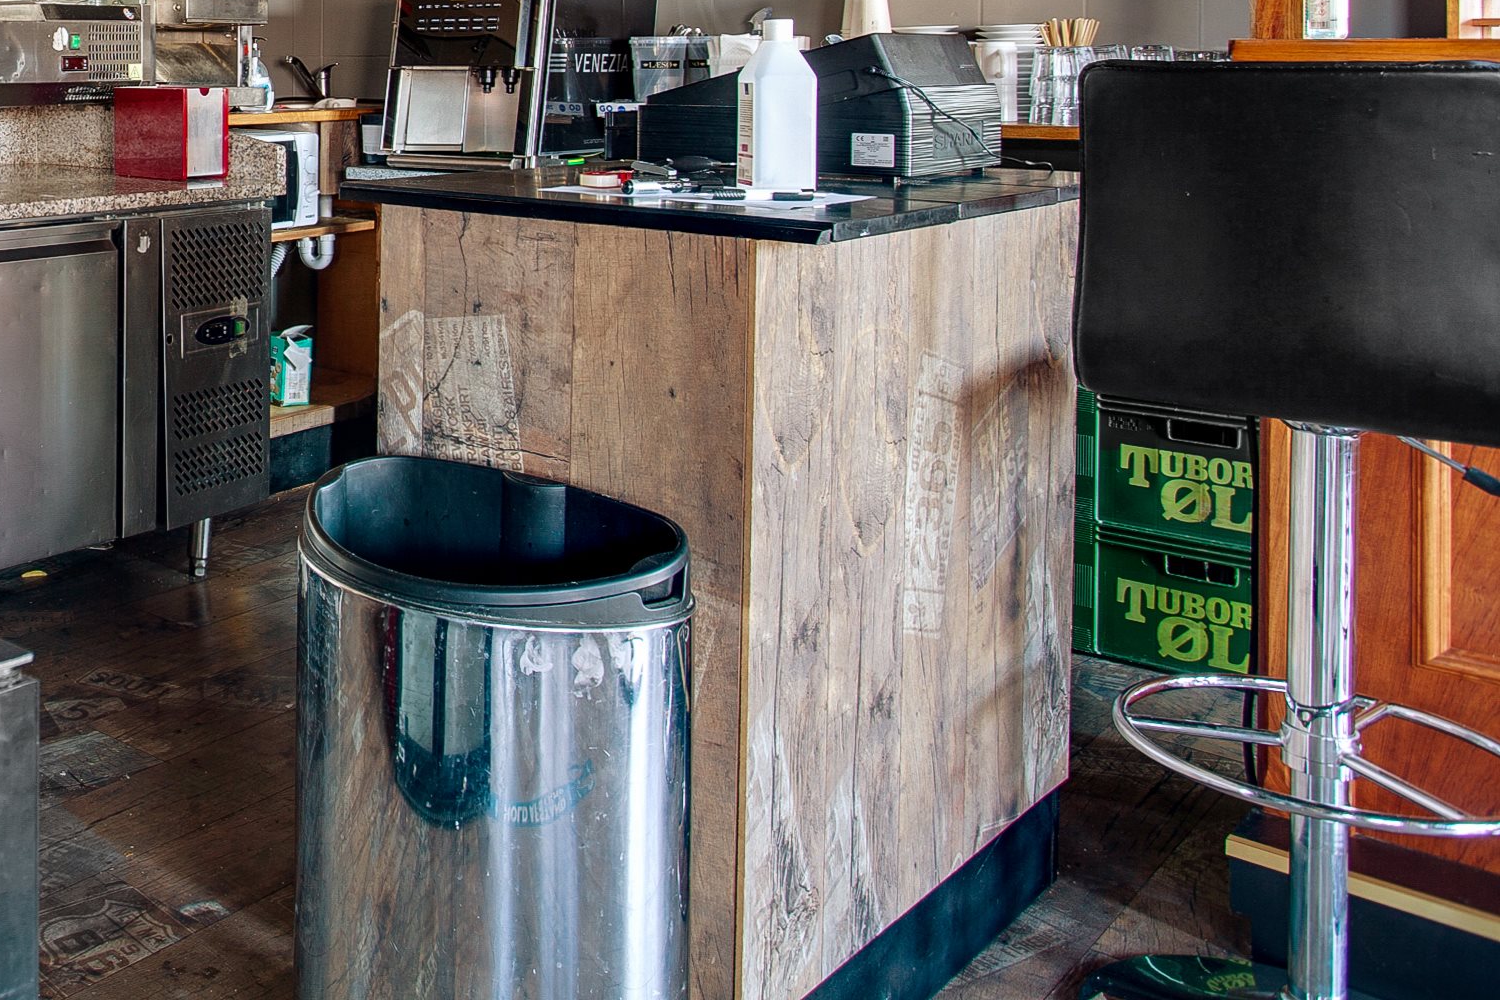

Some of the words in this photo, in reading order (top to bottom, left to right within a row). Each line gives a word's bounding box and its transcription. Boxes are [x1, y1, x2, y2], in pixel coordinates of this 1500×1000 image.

[574, 53, 629, 73] VENEZIA
[934, 130, 980, 151] SHAR
[1120, 443, 1253, 490] TUBOR
[1160, 478, 1253, 534] ØL
[1116, 576, 1252, 631] TUBOR
[1157, 615, 1250, 675] ØL
